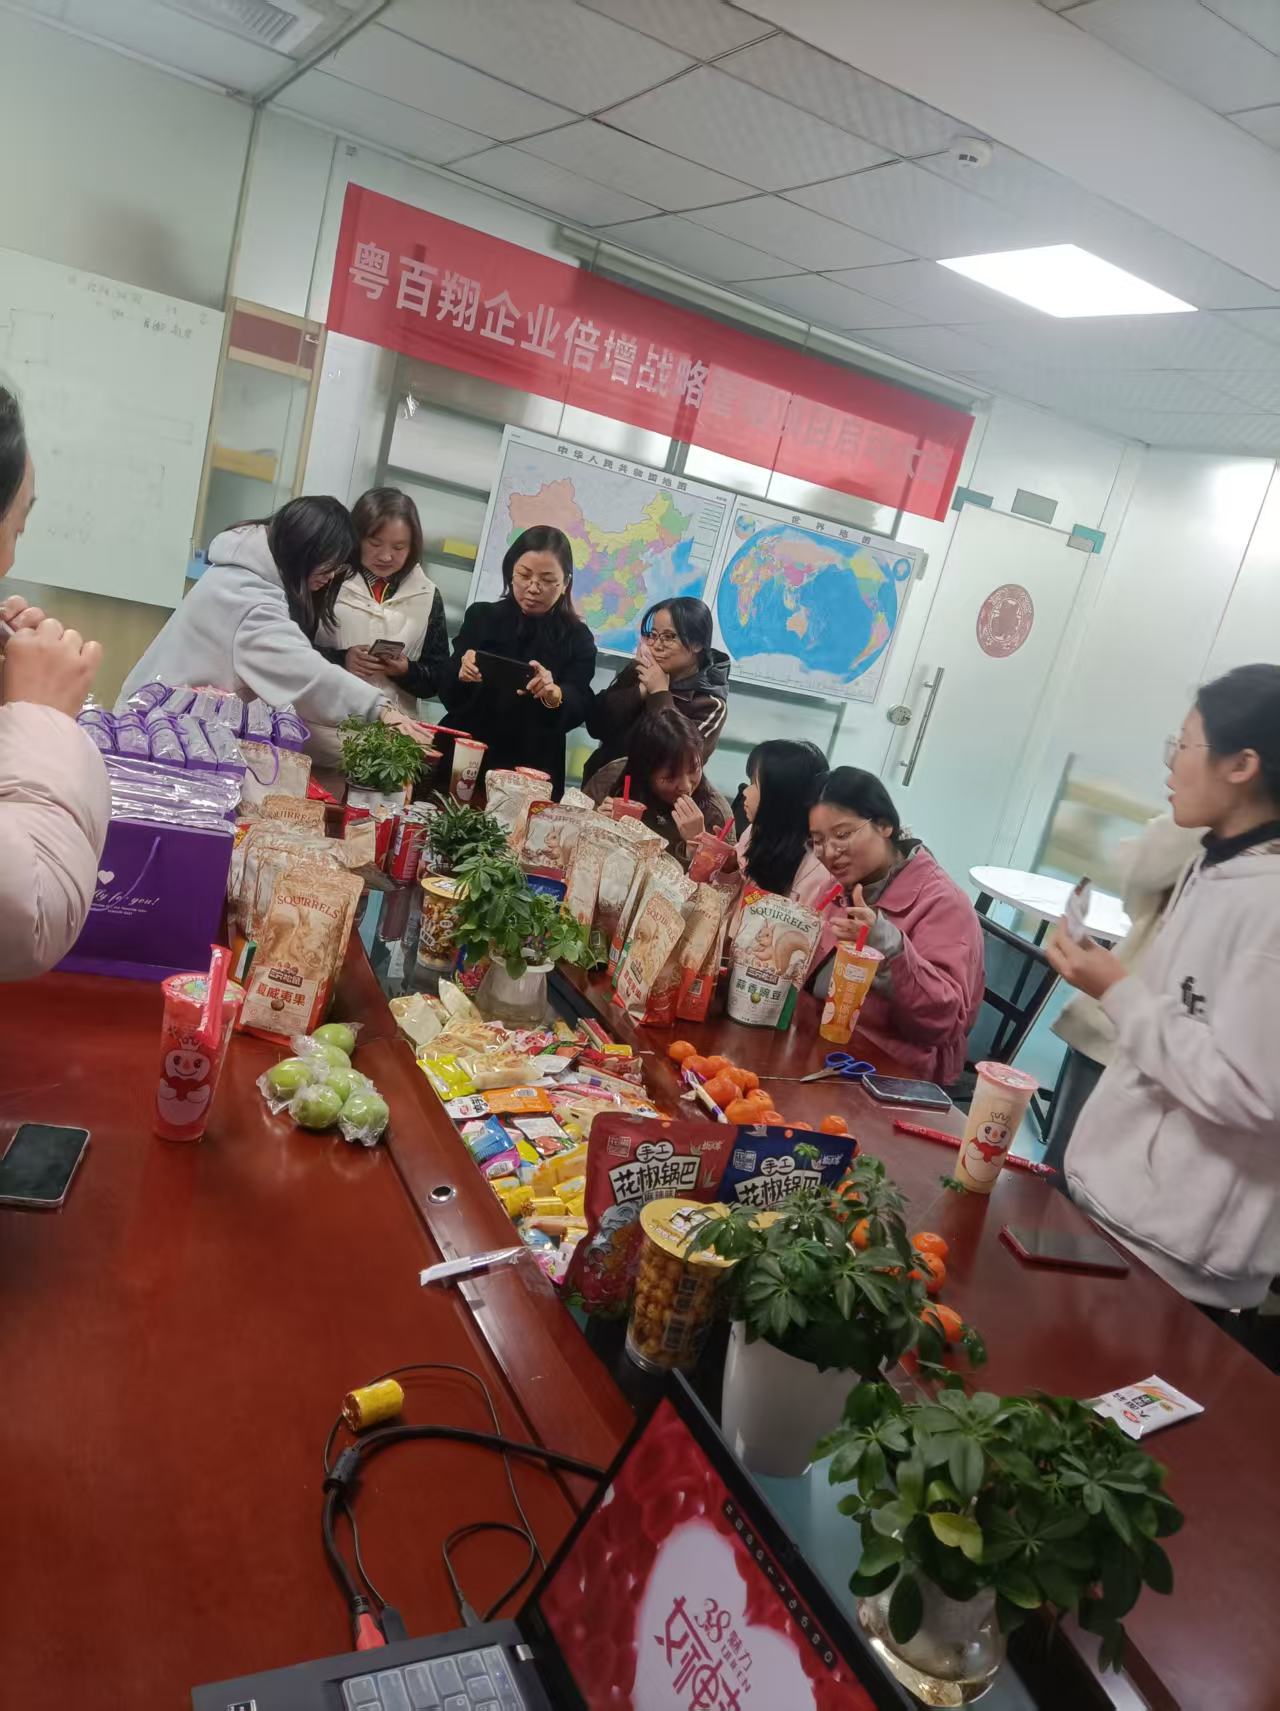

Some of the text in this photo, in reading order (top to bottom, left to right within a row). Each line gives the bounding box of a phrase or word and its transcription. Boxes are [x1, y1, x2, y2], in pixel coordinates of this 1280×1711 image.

[556, 443, 689, 492] 中华人民共和国地图
[790, 514, 873, 545] 世界地图
[276, 895, 341, 920] SQUIRRELS
[749, 906, 812, 933] SQUIRRELS
[256, 982, 306, 1007] 夏威夷果
[735, 978, 783, 1002] 蒜香豌豆
[637, 1143, 671, 1160] 手工
[762, 1158, 793, 1174] 手工
[613, 1160, 698, 1198] 花椒锅巴
